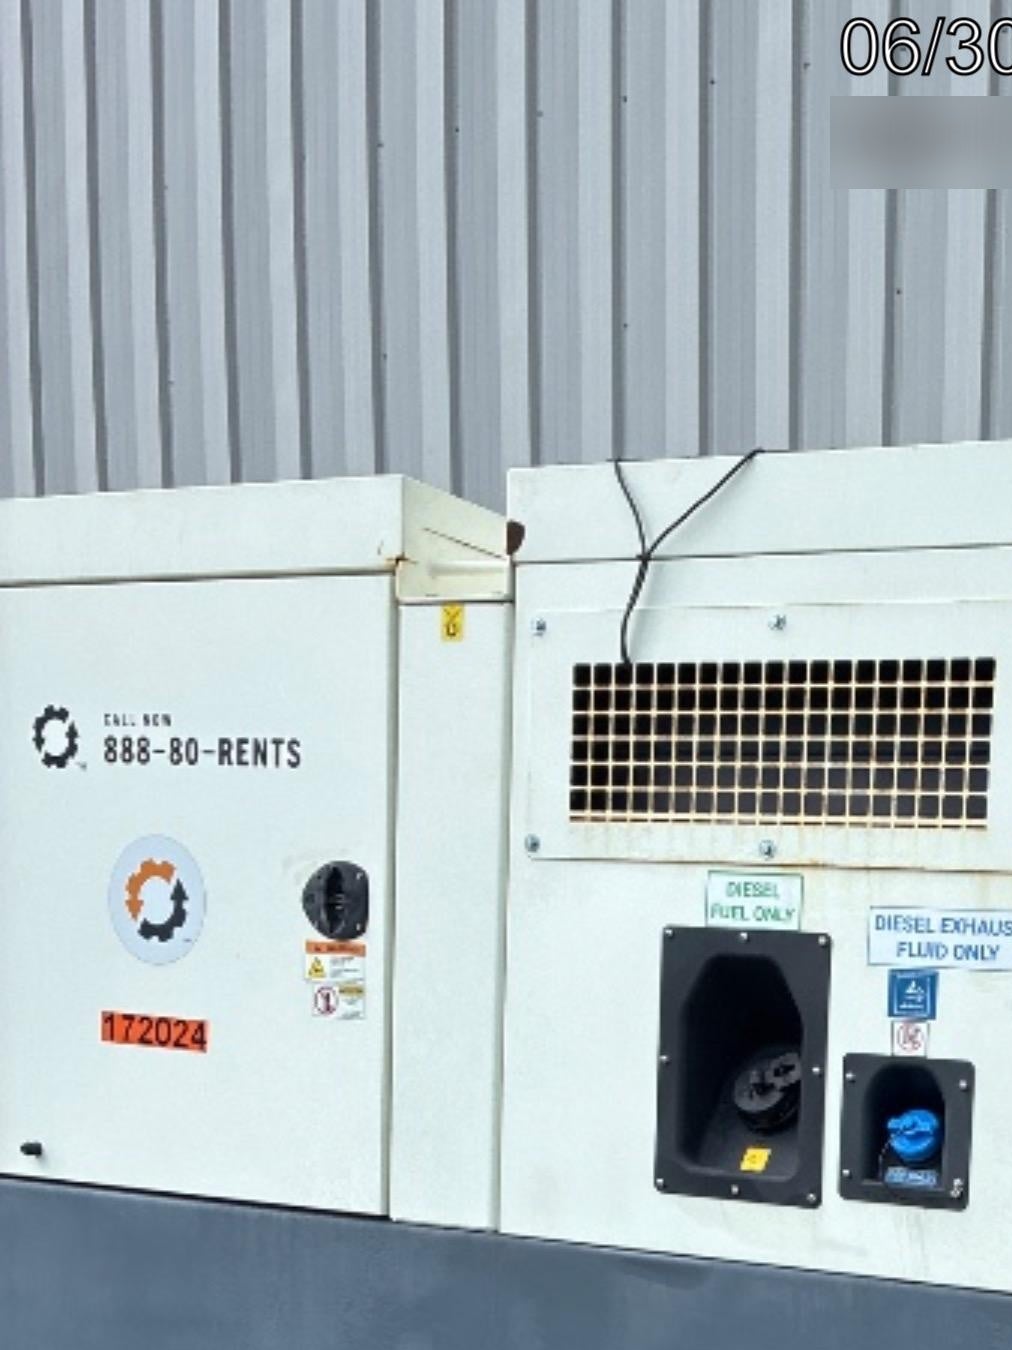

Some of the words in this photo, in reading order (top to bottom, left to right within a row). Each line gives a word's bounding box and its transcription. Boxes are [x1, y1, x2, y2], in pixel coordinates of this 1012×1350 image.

[103, 735, 302, 769] 888-80-RENTS
[725, 880, 781, 901] DIESEL
[709, 902, 751, 920] FUEL
[755, 904, 797, 924] ONLY
[874, 914, 936, 935] DIESEL
[896, 941, 949, 961] FLUID
[953, 943, 1002, 963] ONLY
[103, 1012, 207, 1053] 172024
